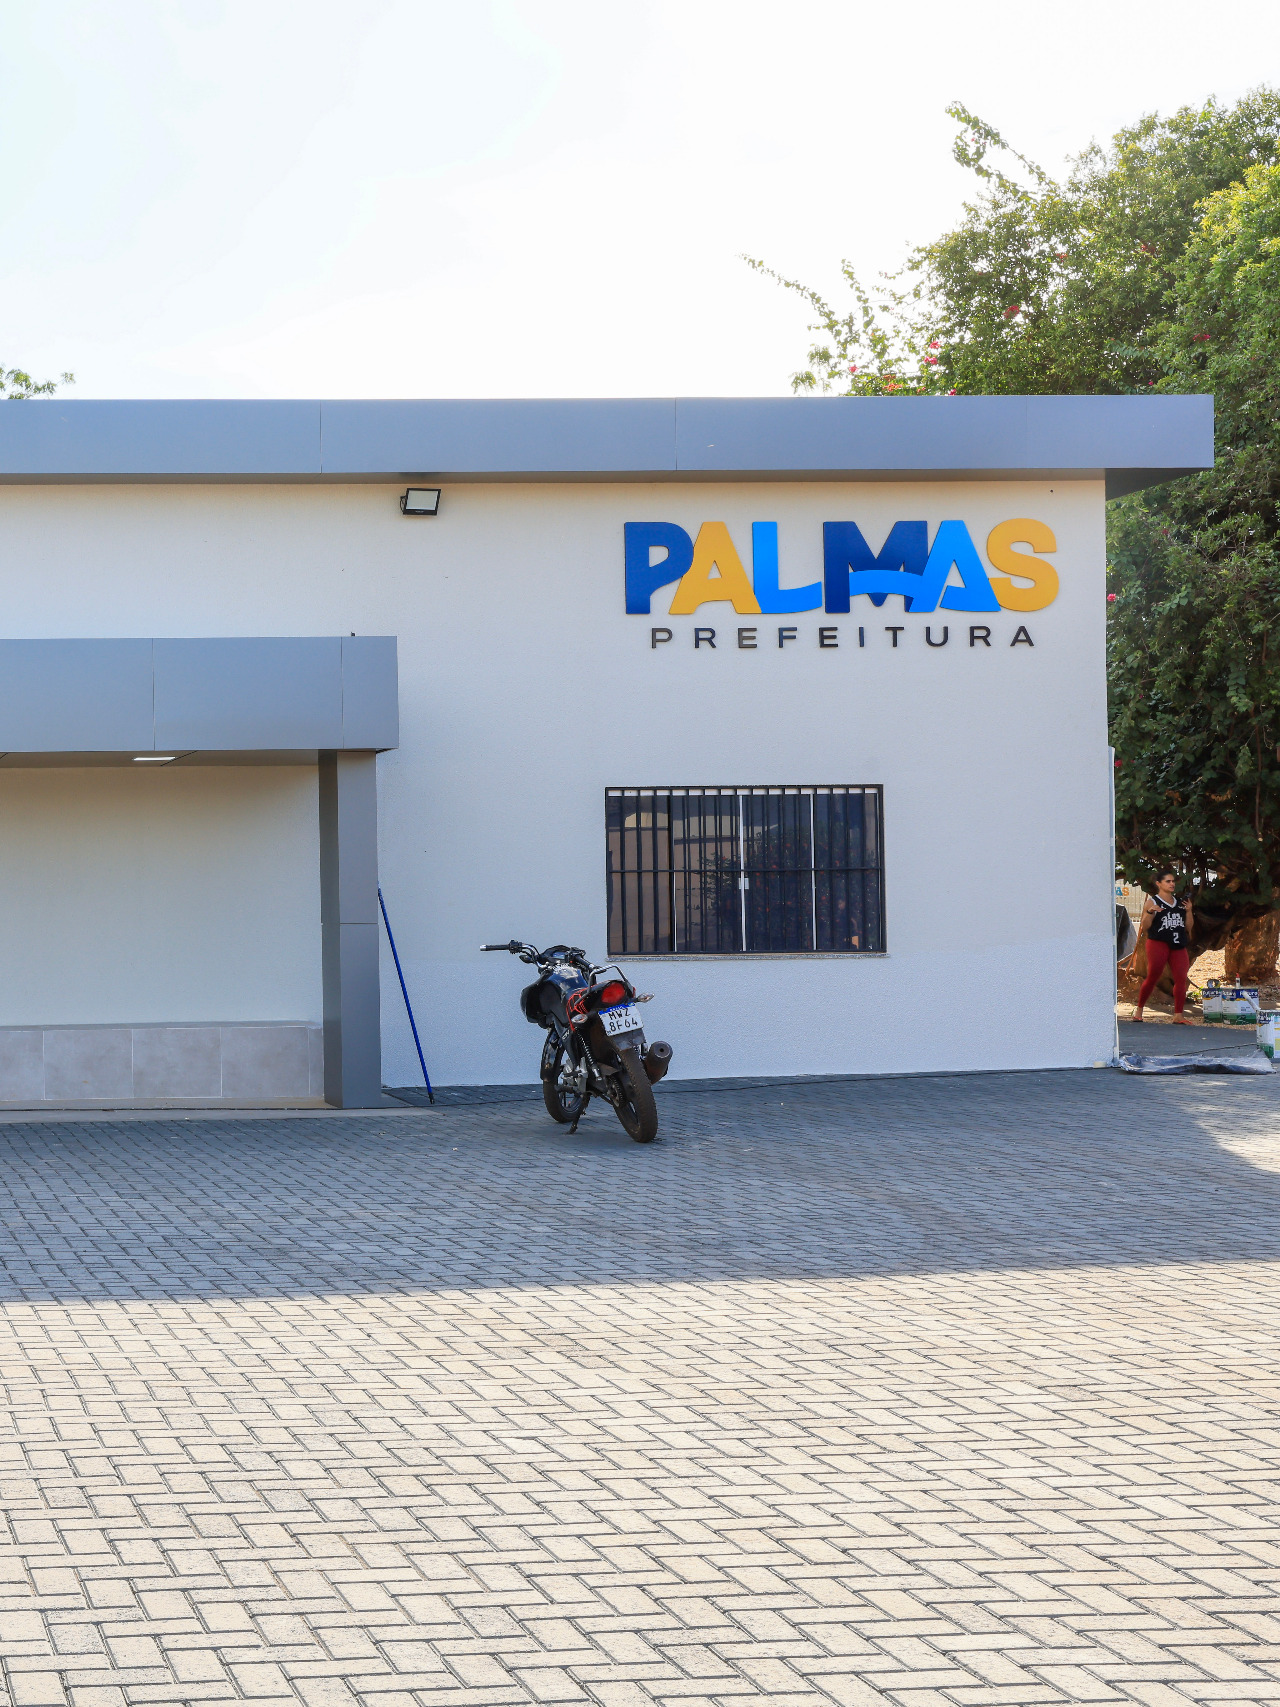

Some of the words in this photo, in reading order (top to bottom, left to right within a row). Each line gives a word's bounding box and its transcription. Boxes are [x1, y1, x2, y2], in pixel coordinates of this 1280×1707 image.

[624, 518, 1060, 615] PALMAS
[651, 625, 1036, 649] PREFEITURA
[1173, 932, 1180, 944] 2
[608, 1008, 631, 1020] MWZ
[610, 1017, 638, 1031] 8F64
